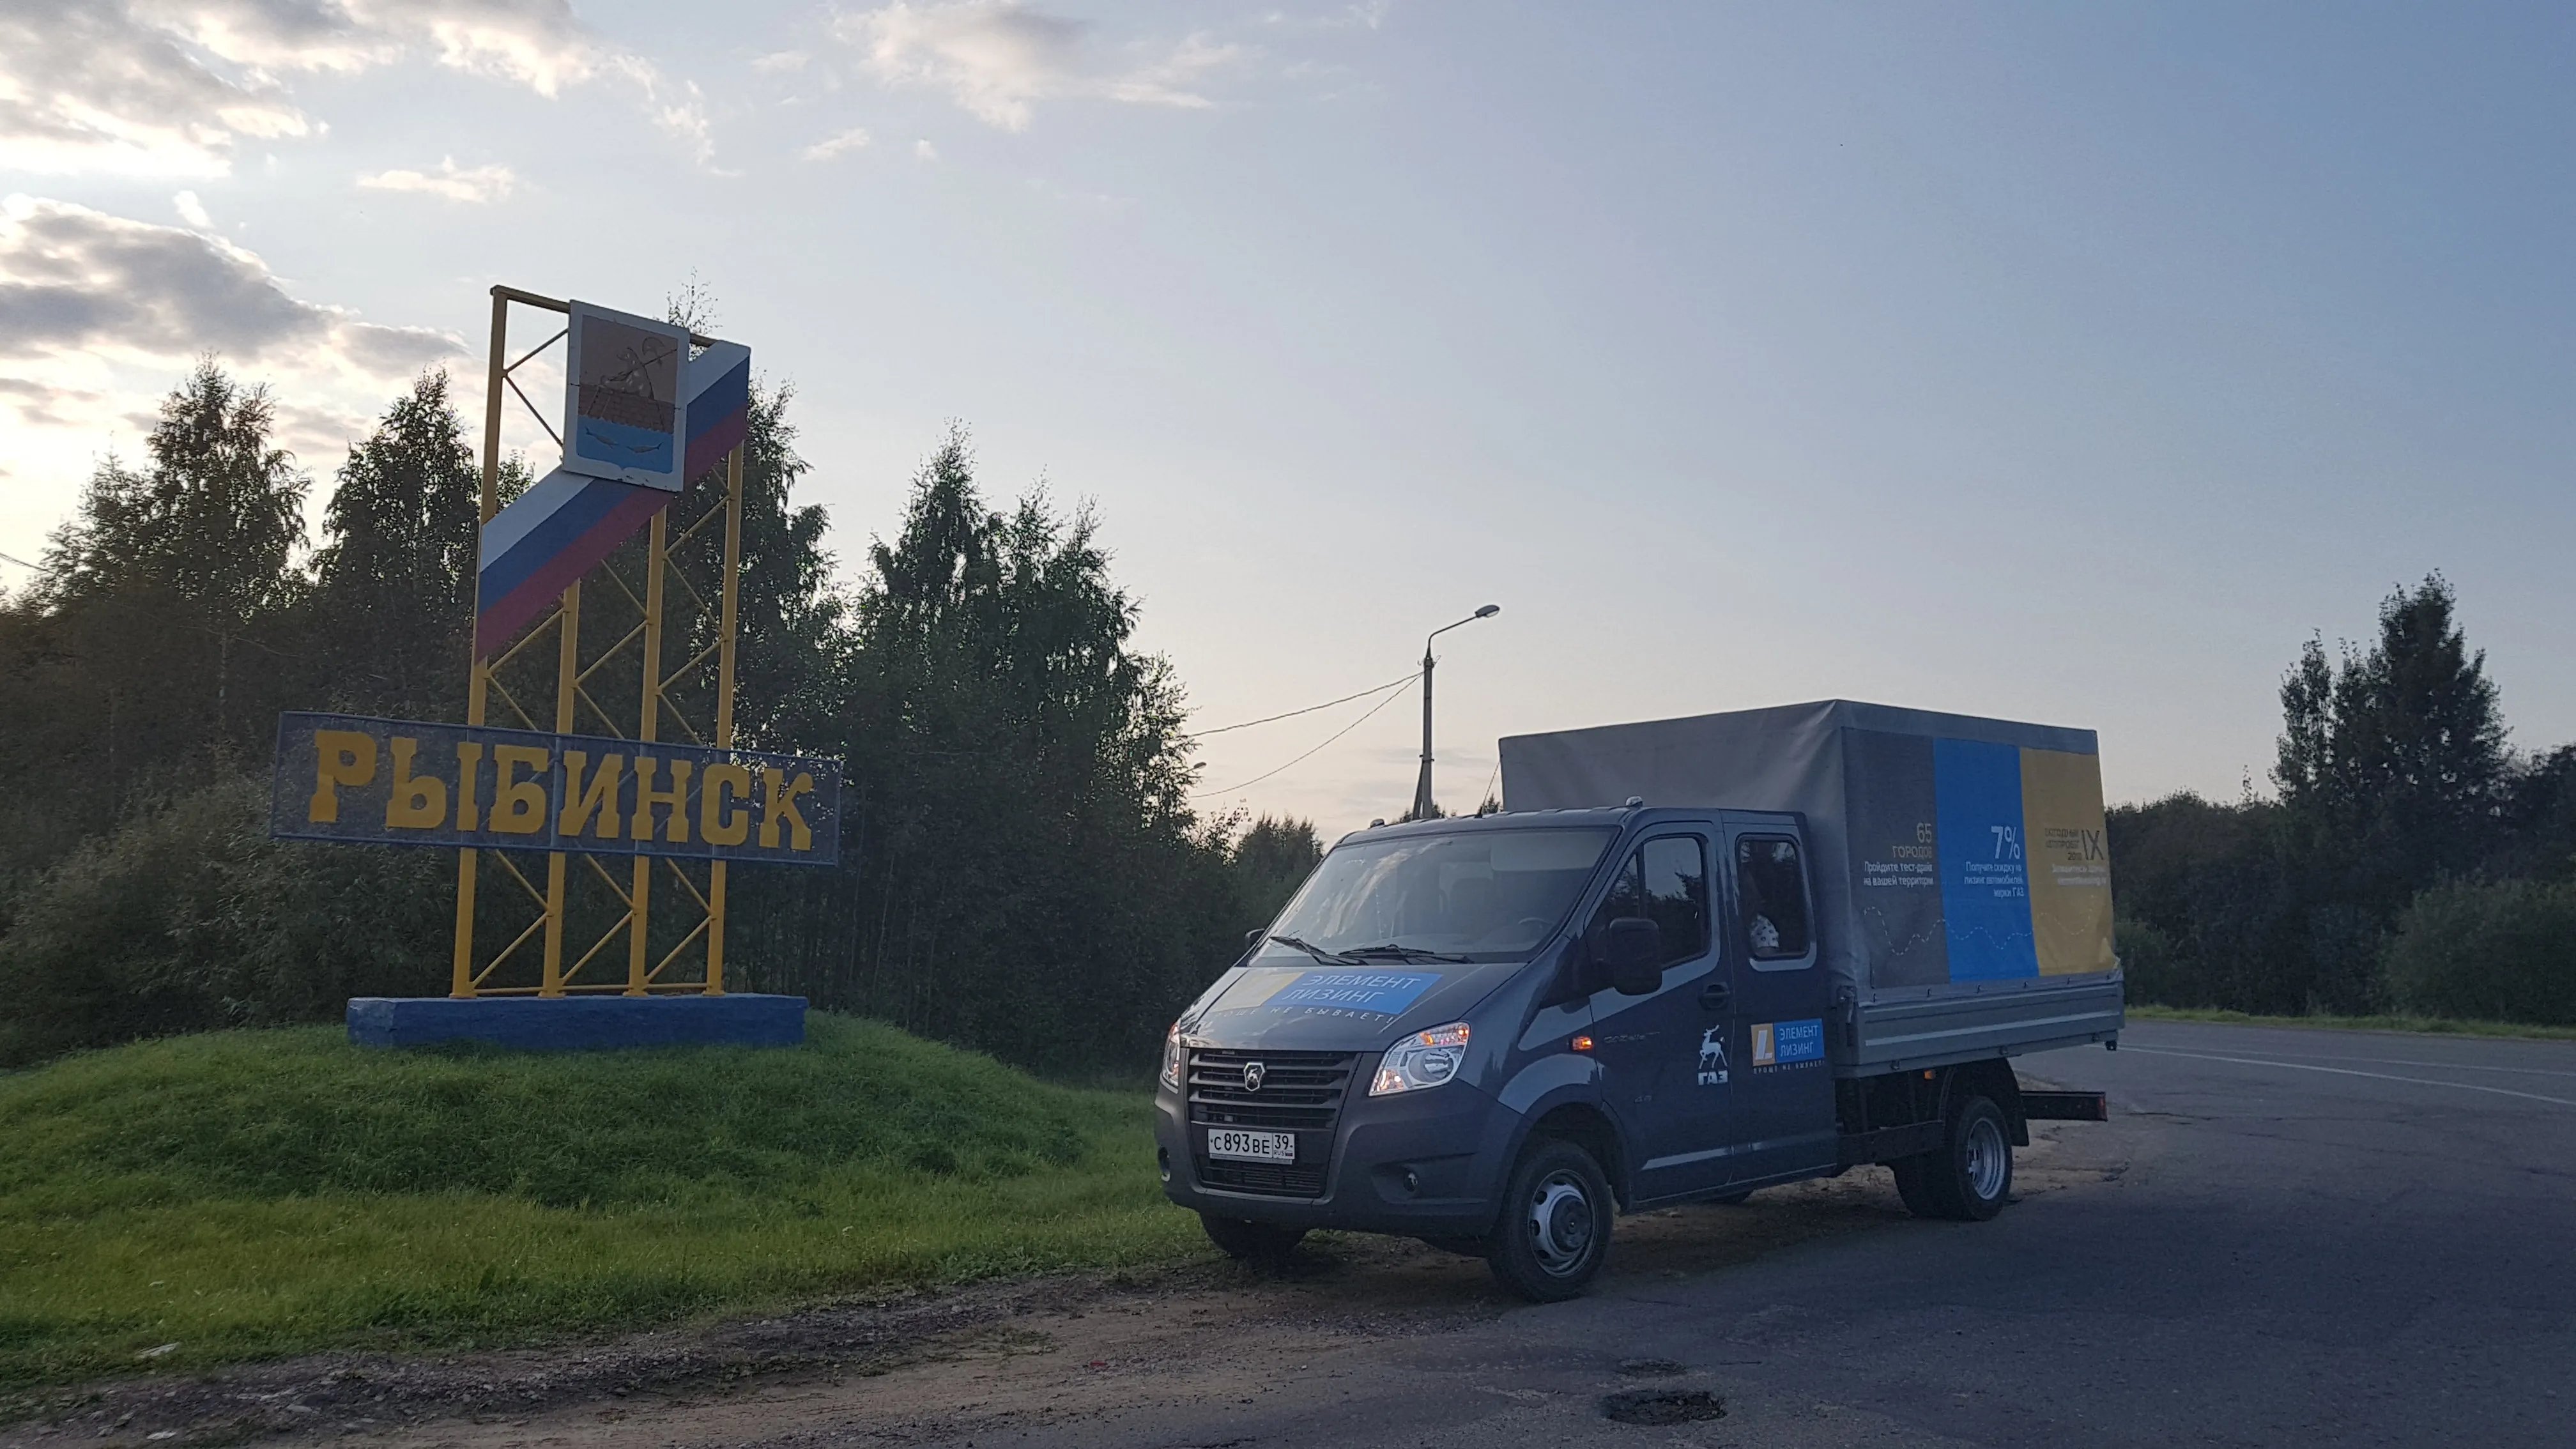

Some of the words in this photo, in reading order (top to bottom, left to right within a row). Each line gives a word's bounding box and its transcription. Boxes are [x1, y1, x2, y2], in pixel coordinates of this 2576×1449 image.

[309, 730, 813, 851] РЫБИНСК
[1917, 822, 1932, 843] 65
[1991, 826, 2021, 859] 7%
[2082, 829, 2104, 860] IX
[1864, 861, 1899, 874] Пройдите
[1864, 877, 1871, 885] на
[1873, 875, 1897, 885] вашей
[2012, 887, 2024, 896] ГАЗ
[1302, 975, 1422, 990] ЭЛЕМЕНТ
[1282, 988, 1385, 1004] ЛИЗИНГ
[1303, 1007, 1394, 1023] БЫВАЕТ!
[1779, 1025, 1818, 1041] ЭЛЕМЕНТ
[1780, 1042, 1814, 1057] ЛИЗИНГ
[1698, 1070, 1728, 1086] ГАЗ
[1214, 1133, 1269, 1154] С893ВЕ
[1275, 1135, 1289, 1150] 39
